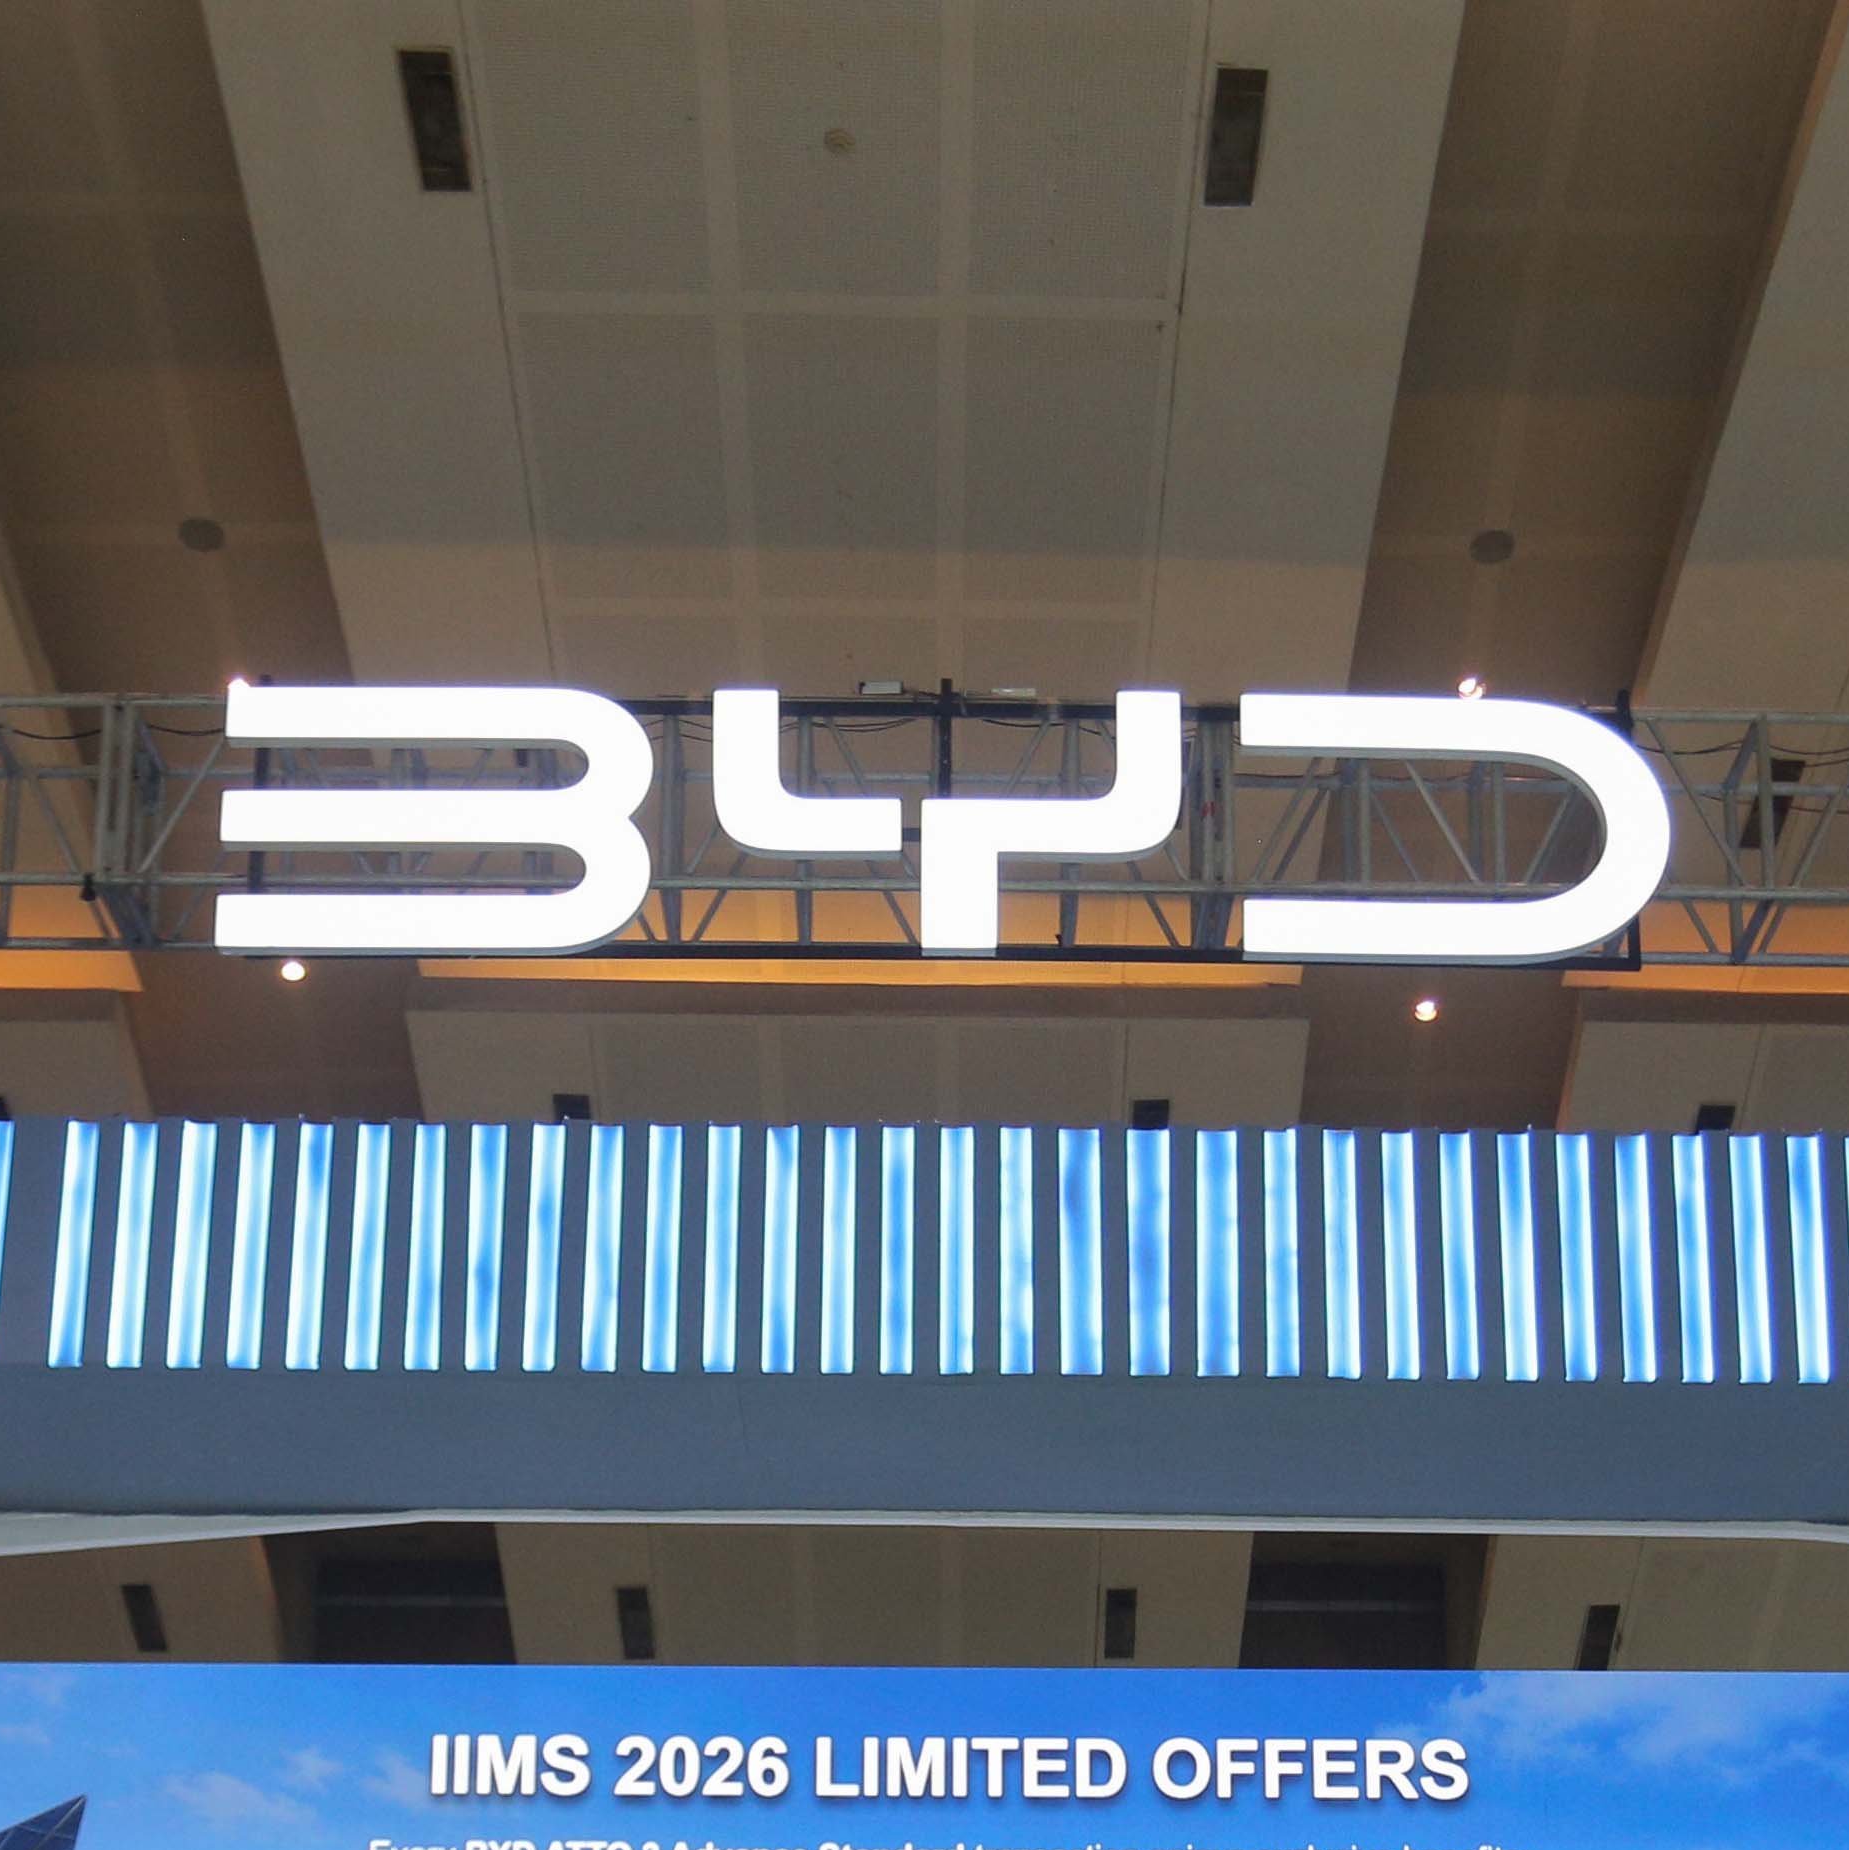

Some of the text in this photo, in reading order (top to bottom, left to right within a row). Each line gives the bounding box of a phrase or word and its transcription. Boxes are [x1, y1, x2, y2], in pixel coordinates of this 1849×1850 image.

[216, 686, 1670, 962] BYD
[431, 1734, 1470, 1801] IIMS 2026 LIMITED OFFERS
